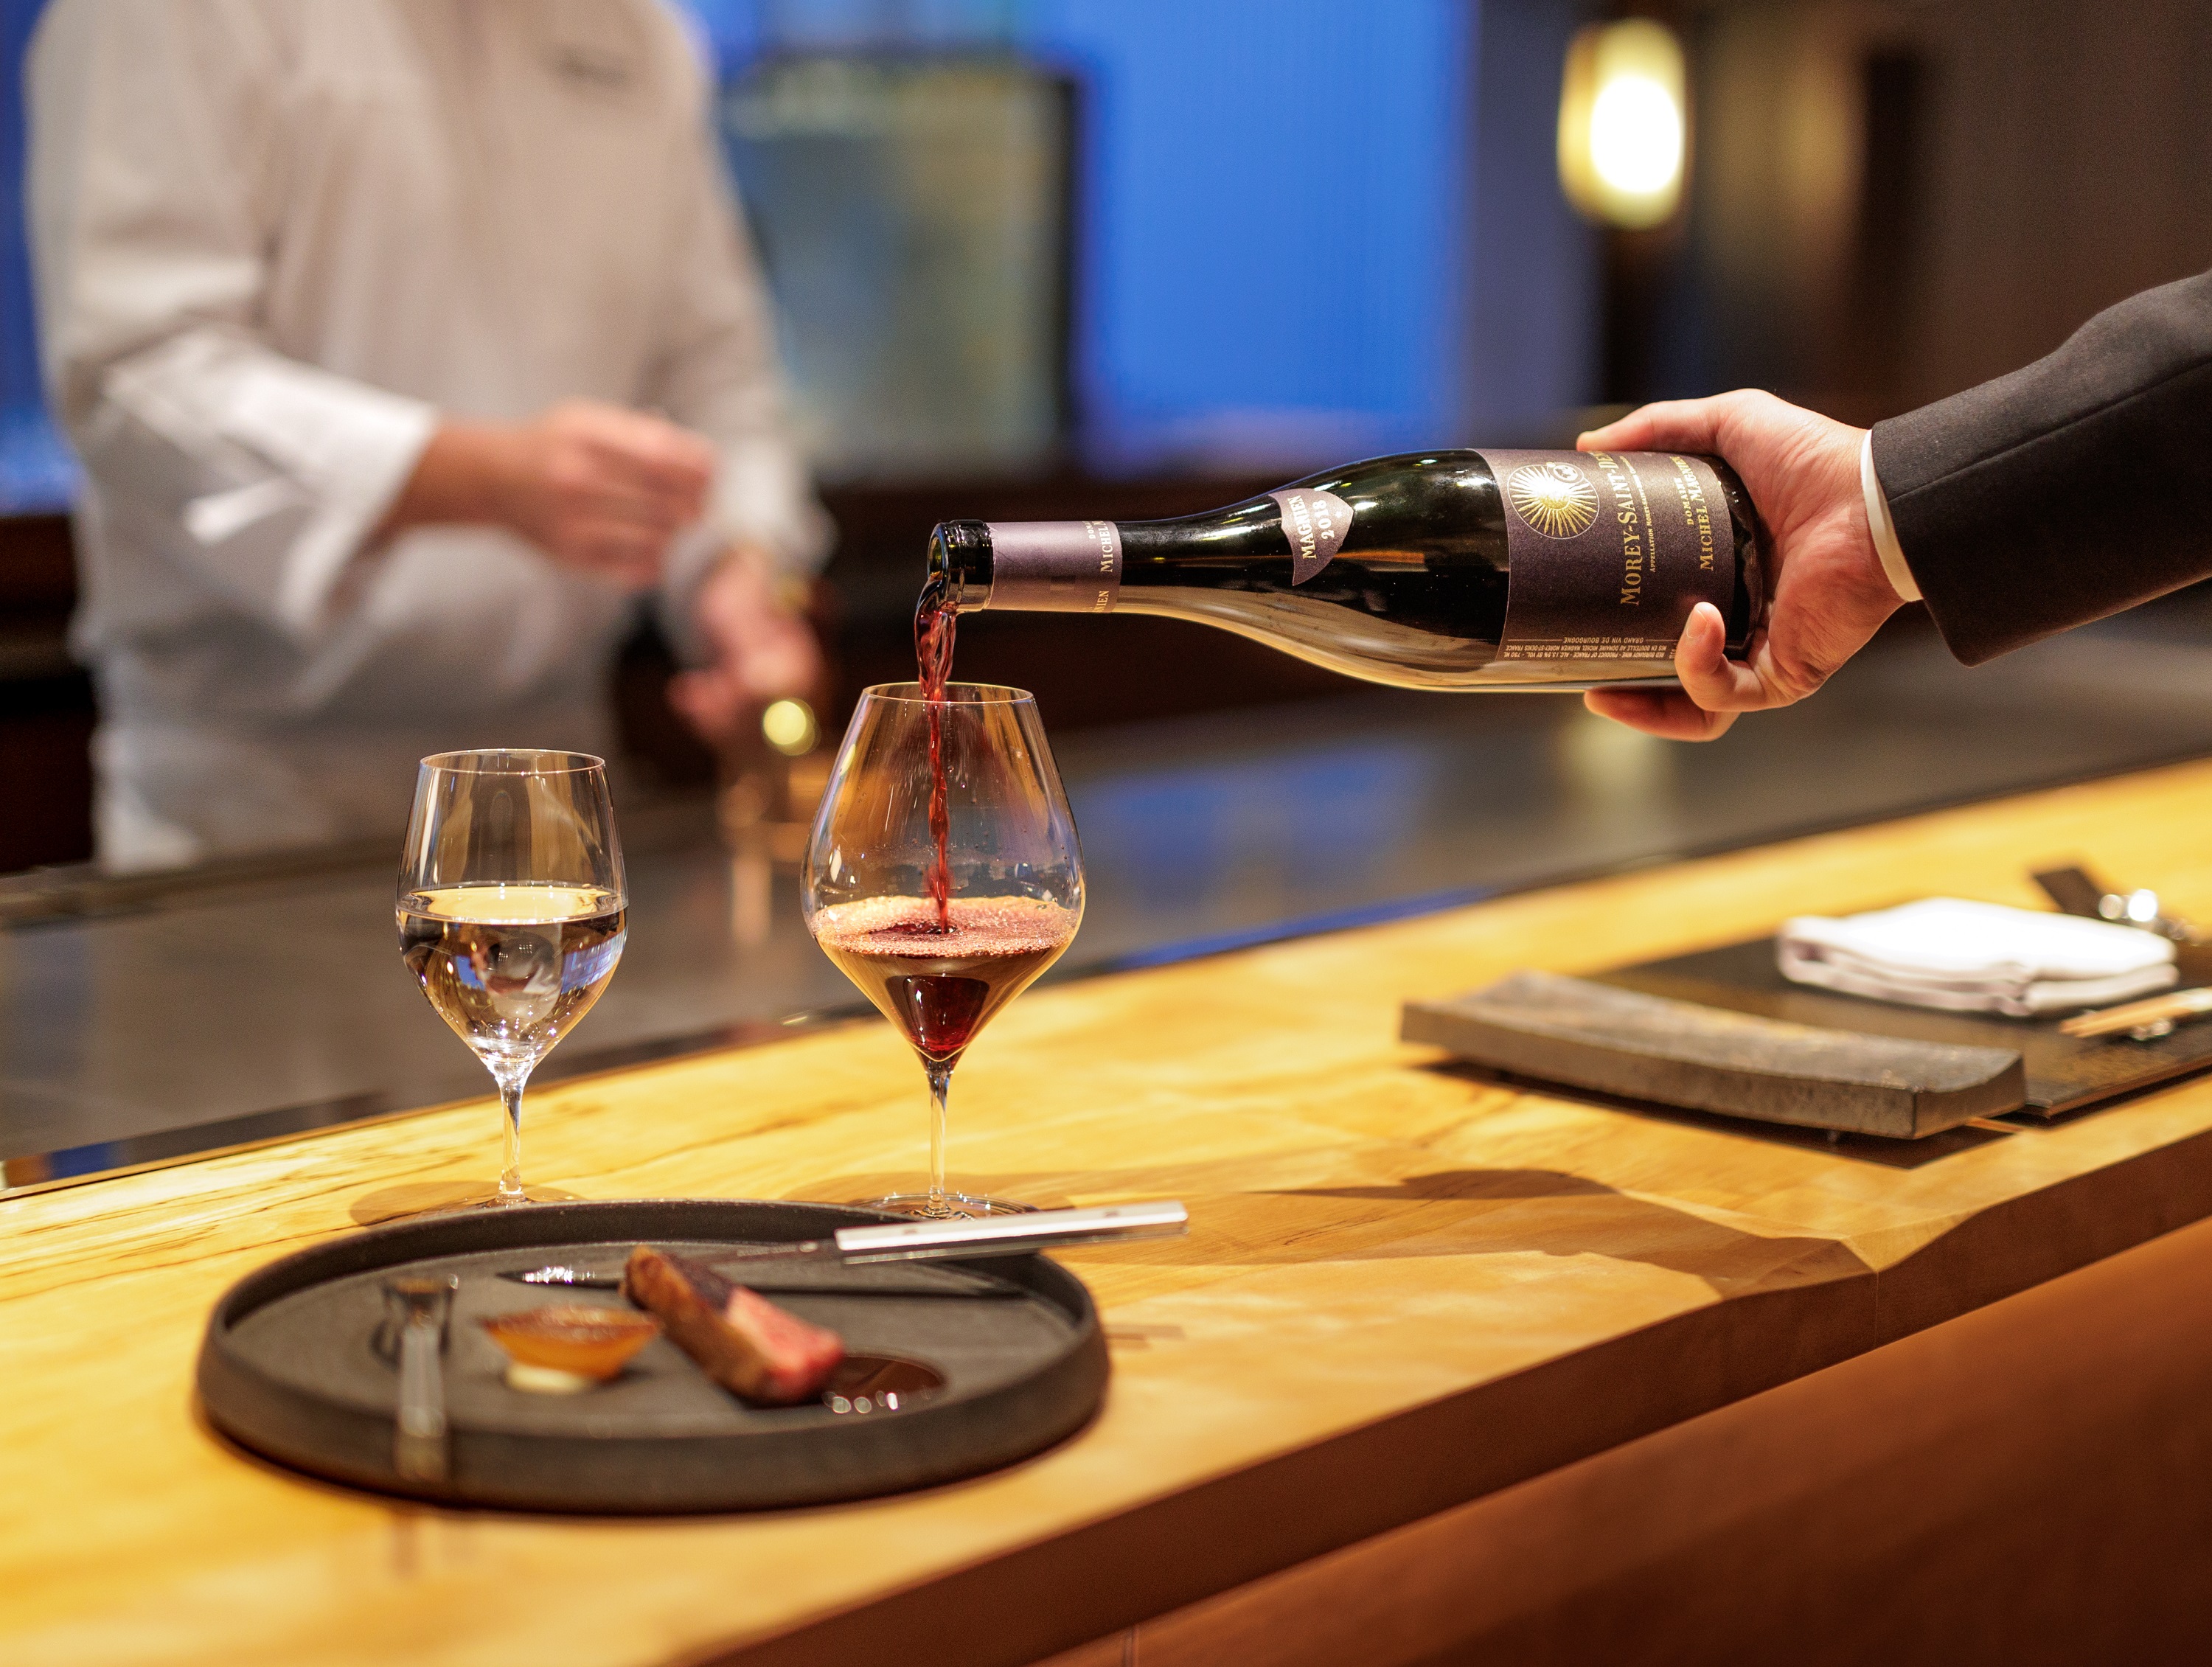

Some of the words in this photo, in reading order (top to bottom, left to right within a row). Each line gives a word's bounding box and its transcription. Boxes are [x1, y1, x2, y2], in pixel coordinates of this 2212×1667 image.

[1312, 499, 1335, 540] 2018
[1674, 476, 1694, 526] DOMAINE
[1098, 526, 1113, 573] MICHEL
[1287, 494, 1318, 560] MAGNIEN
[1647, 528, 1656, 573] APPELLATION
[1695, 505, 1714, 571] MICHEL
